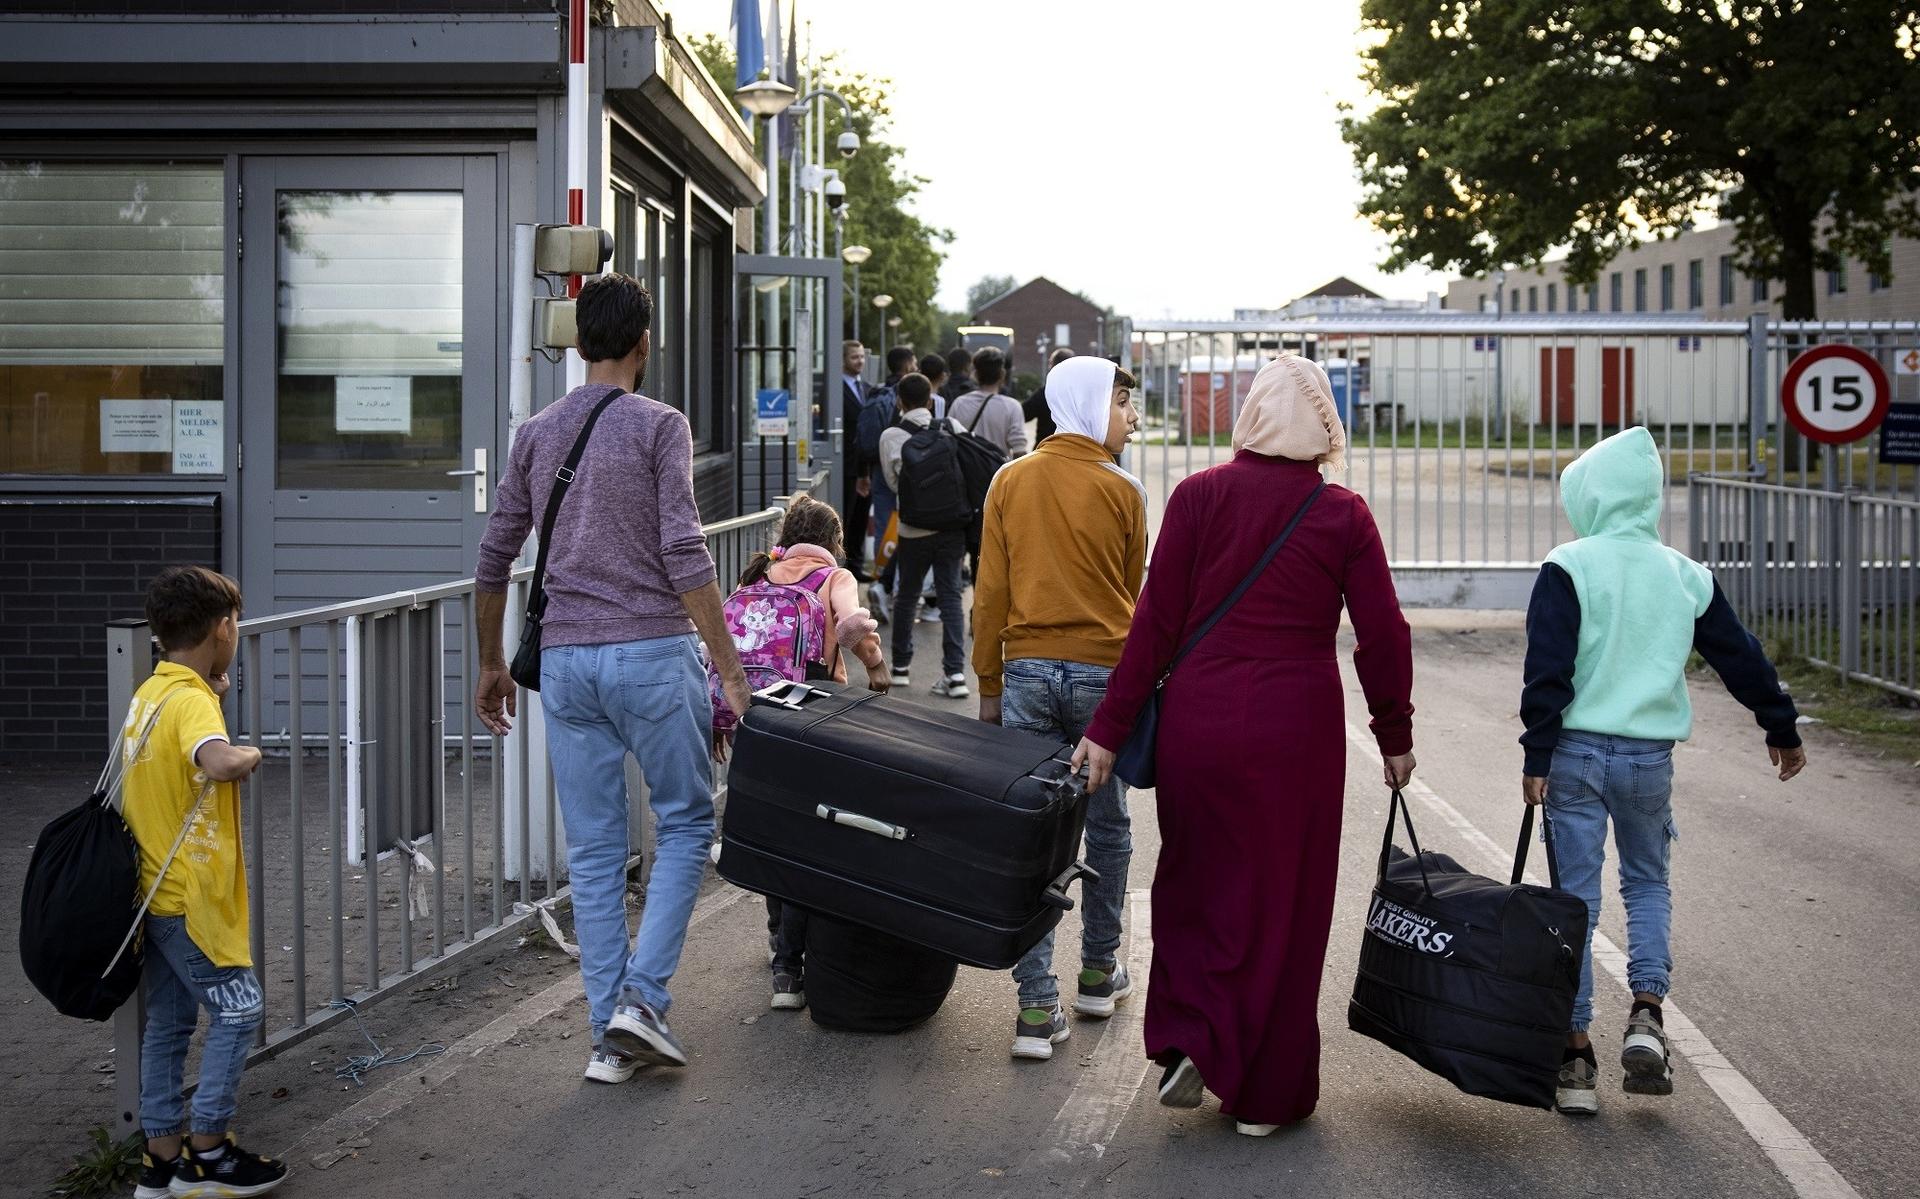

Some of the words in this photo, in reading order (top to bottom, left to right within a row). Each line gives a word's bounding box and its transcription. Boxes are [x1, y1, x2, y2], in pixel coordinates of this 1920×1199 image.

[1808, 376, 1863, 412] 15
[181, 429, 205, 437] A.U.B.
[185, 835, 219, 850] FASHION
[191, 852, 211, 863] NEW
[1384, 901, 1404, 914] BEST
[1403, 909, 1438, 927] QUALITY
[1366, 895, 1453, 953] LAKERS
[603, 1054, 621, 1067] NIKE
